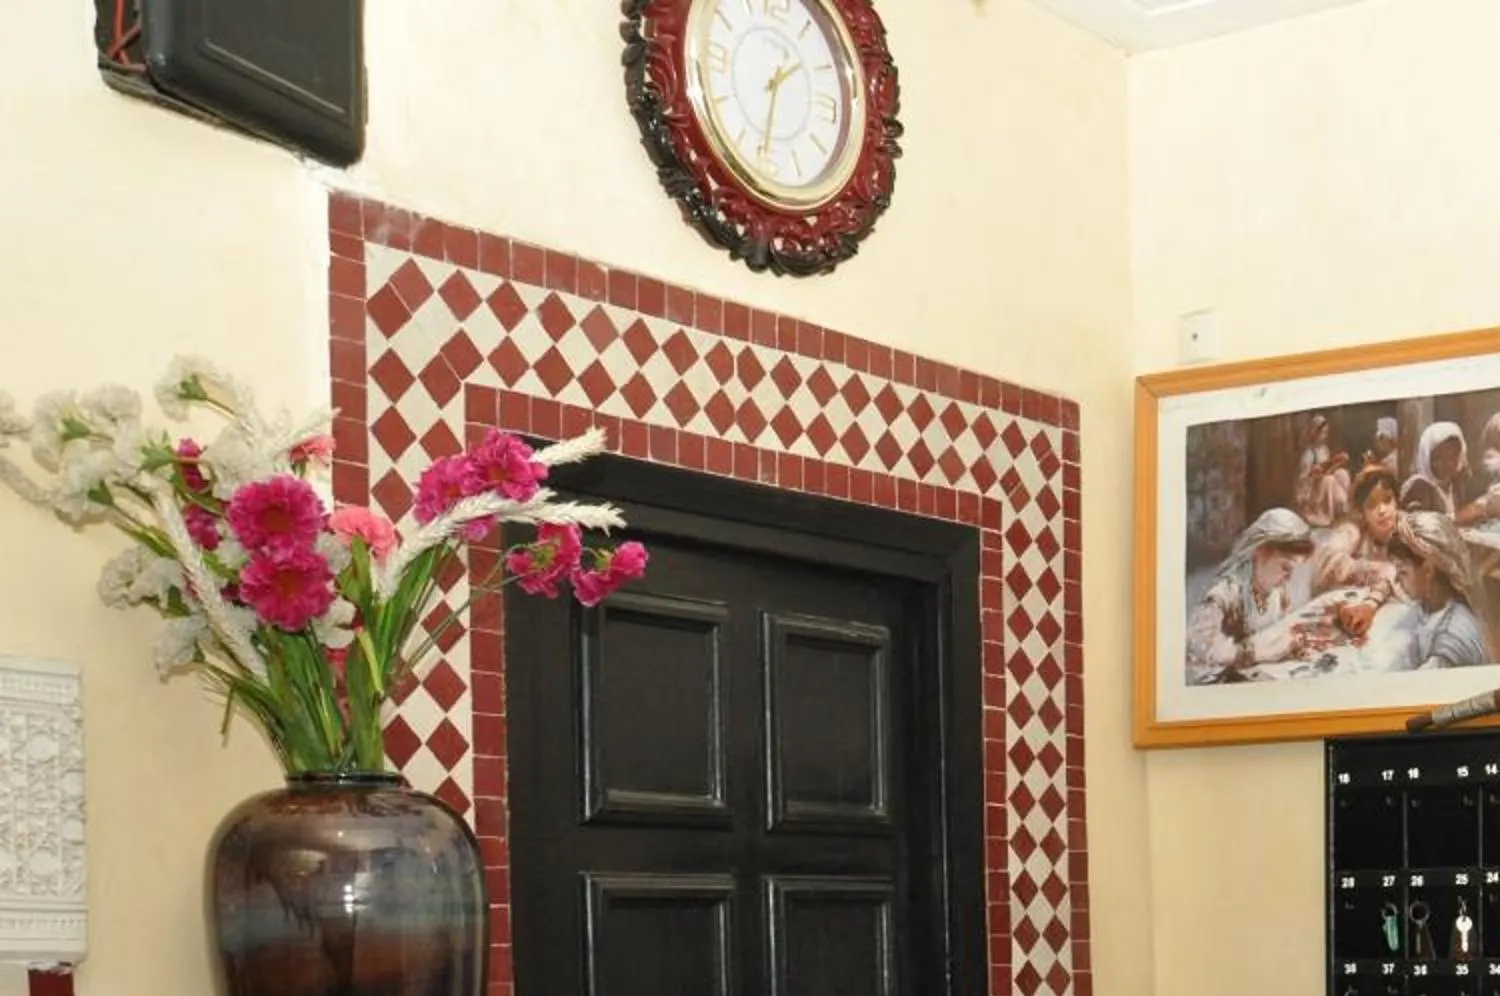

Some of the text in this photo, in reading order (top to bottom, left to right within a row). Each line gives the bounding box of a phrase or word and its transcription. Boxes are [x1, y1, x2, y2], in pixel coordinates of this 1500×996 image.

[1381, 769, 1394, 781] 17
[1456, 765, 1469, 778] 15
[1485, 763, 1499, 775] 14
[1383, 875, 1396, 887] 27
[1455, 873, 1469, 886] 25
[1486, 871, 1499, 884] 24
[1382, 962, 1395, 975] 37
[1455, 963, 1469, 976] 35
